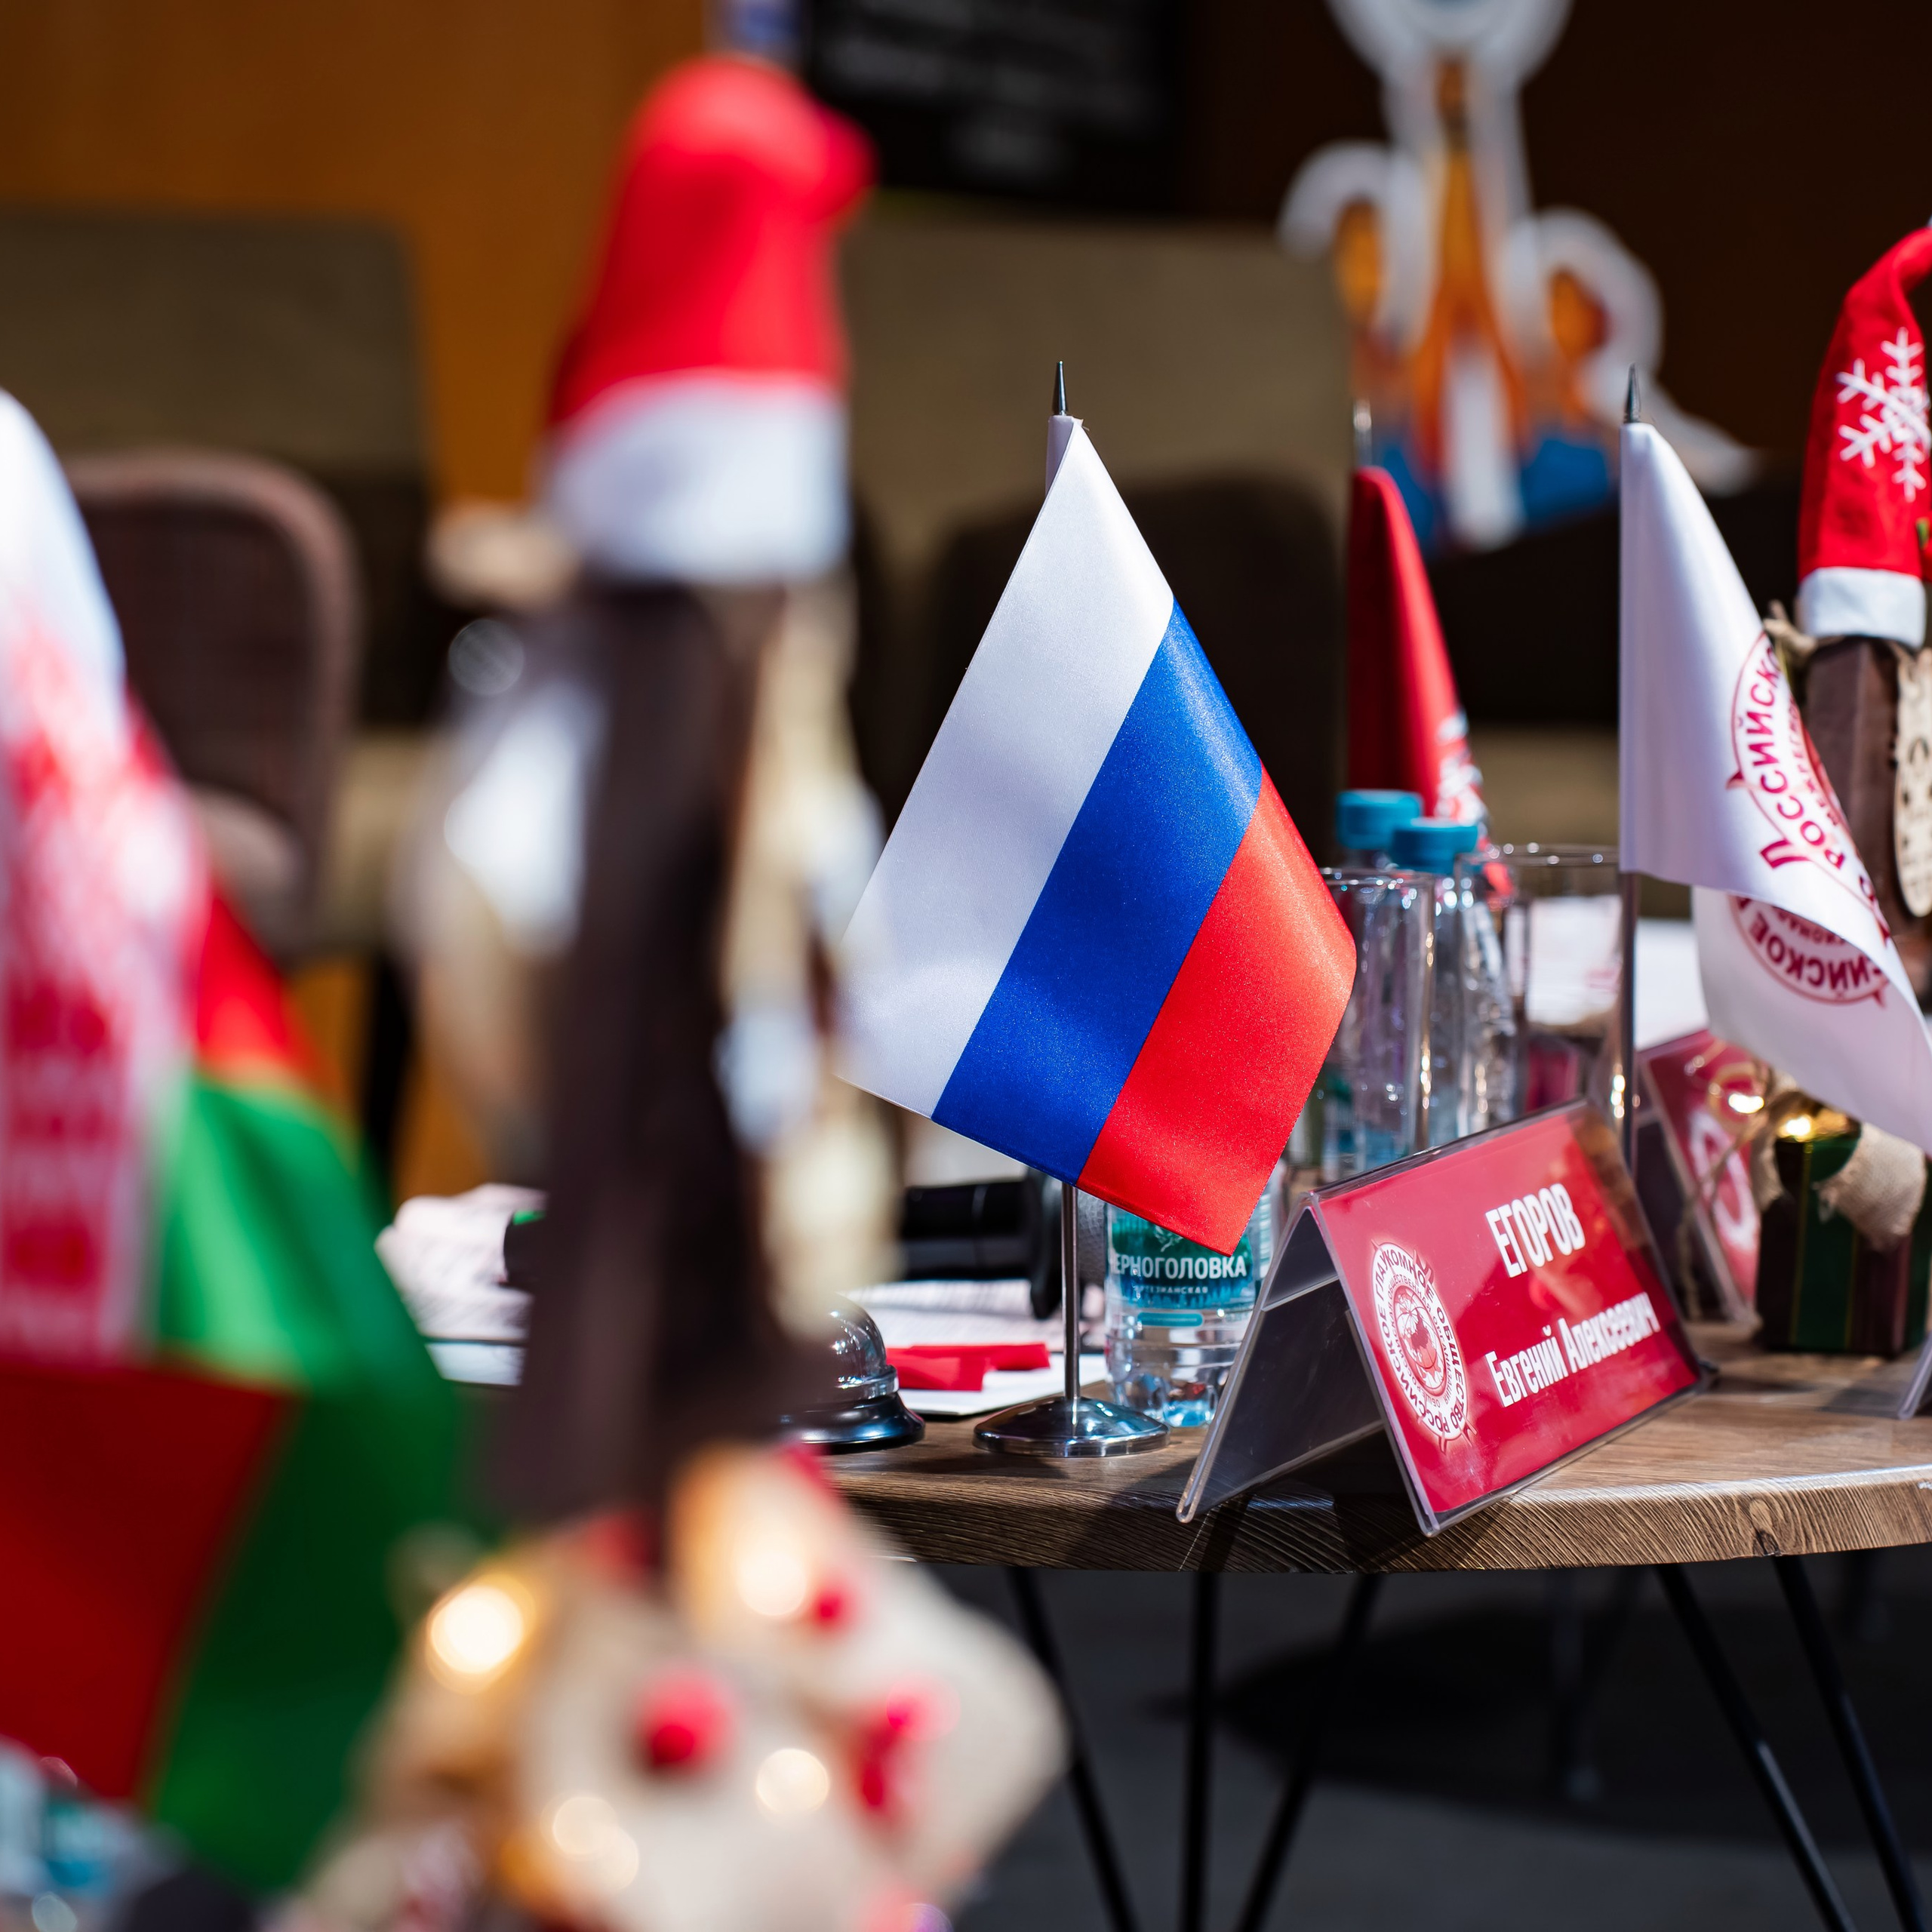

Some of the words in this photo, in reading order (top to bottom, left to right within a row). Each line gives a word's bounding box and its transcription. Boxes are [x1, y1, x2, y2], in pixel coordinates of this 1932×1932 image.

[1749, 912, 1881, 996] ИЙСКОЕ
[1109, 1253, 1247, 1279] ЕРНОГОЛОВКА
[1375, 1248, 1434, 1303] ГЛАУКОМНОЕ
[1485, 1183, 1586, 1278] ЕГОРОВ
[1377, 1303, 1451, 1433] РОССИЙСКОЕ
[1436, 1306, 1465, 1429] ОБЩЕСТВО
[1485, 1324, 1569, 1407] Евгений
[1558, 1291, 1660, 1374] Алексеевич
